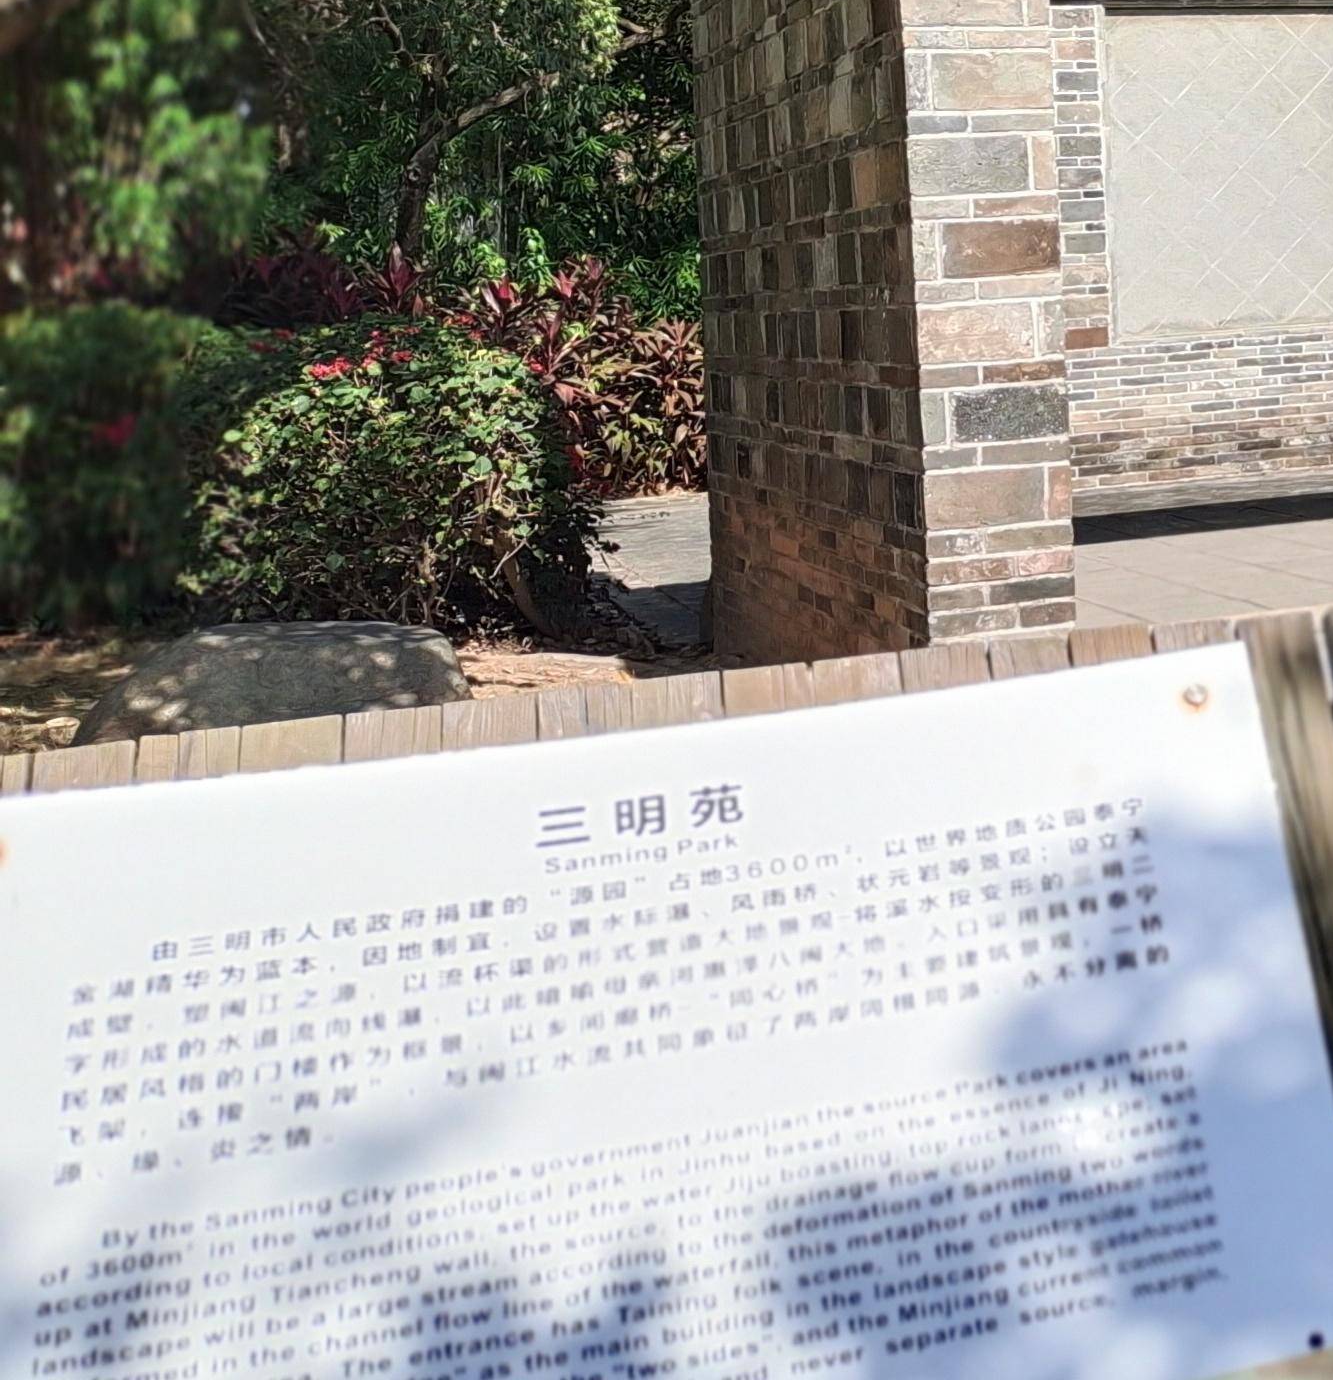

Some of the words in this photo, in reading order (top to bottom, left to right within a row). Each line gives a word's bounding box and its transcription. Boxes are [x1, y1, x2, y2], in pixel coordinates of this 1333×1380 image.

[535, 783, 744, 848] 三明苑
[544, 845, 668, 874] Sanming
[676, 832, 739, 856] Park
[35, 1274, 191, 1321] according
[203, 1270, 230, 1289] to
[243, 1252, 313, 1281] local
[497, 1212, 535, 1235] set
[547, 1207, 579, 1227] up
[590, 1194, 630, 1217] the
[642, 1182, 712, 1208] water
[907, 1136, 948, 1158] top
[957, 1121, 1009, 1146] rock
[38, 1267, 70, 1289] of
[209, 1240, 235, 1258] in
[251, 1227, 295, 1251] the
[312, 1210, 391, 1240] world
[407, 1182, 551, 1227] geological
[567, 1169, 624, 1198] park
[641, 1164, 663, 1181] in
[678, 1146, 750, 1174] Jinhu
[765, 1129, 841, 1158] based
[854, 1124, 885, 1141] on
[897, 1111, 934, 1132] the
[949, 1091, 1050, 1123] essence
[1061, 1081, 1086, 1099] of
[1096, 1074, 1118, 1092] Ji
[101, 1228, 139, 1250] By
[148, 1216, 195, 1240] the
[205, 1194, 332, 1232] Sanming
[341, 1184, 394, 1211] City
[405, 1161, 522, 1202] people's
[531, 1131, 690, 1179] government
[816, 1100, 855, 1122] the
[863, 1086, 945, 1113] source
[954, 1071, 1007, 1095] Park
[1015, 1057, 1096, 1084] covers
[1101, 1050, 1130, 1066] an
[1137, 1039, 1187, 1059] area
[30, 1334, 192, 1380] landscape
[204, 1319, 255, 1345] will
[265, 1314, 299, 1334] be
[311, 1310, 325, 1326] a
[338, 1293, 410, 1323] large
[421, 1273, 517, 1305] stream
[529, 1242, 667, 1286] according
[677, 1238, 701, 1256] to
[713, 1225, 753, 1248] the
[762, 1193, 921, 1239] deformation
[928, 1186, 955, 1206] of
[962, 1162, 1072, 1202] Sanming
[1079, 1153, 1123, 1174] two
[33, 1327, 71, 1350] up
[84, 1316, 113, 1338] at
[124, 1290, 256, 1335] Minjiang
[270, 1260, 421, 1306] Tiancheng
[509, 1236, 551, 1260] the
[678, 1211, 701, 1228] to
[714, 1198, 754, 1221] the
[765, 1178, 878, 1214] drainage
[889, 1165, 939, 1188] flow
[949, 1154, 995, 1177] cup
[1004, 1139, 1062, 1163] form
[212, 1355, 238, 1375] in
[249, 1341, 295, 1367] the
[308, 1317, 423, 1356] channel
[433, 1307, 491, 1332] flow
[502, 1295, 553, 1318] line
[564, 1285, 592, 1306] of
[601, 1275, 642, 1299] the
[788, 1237, 836, 1262] this
[846, 1209, 969, 1252] metaphor
[977, 1202, 1003, 1222] of
[1010, 1192, 1049, 1215] the
[341, 1353, 391, 1380] The
[409, 1327, 534, 1366] entrance
[552, 1314, 599, 1338] has
[618, 1289, 718, 1327] Taining
[733, 1276, 782, 1301] folk
[896, 1249, 921, 1267] in
[934, 1235, 974, 1259] the
[479, 1362, 511, 1380] as
[524, 1346, 568, 1372] the
[580, 1330, 649, 1361] main
[662, 1305, 774, 1346] building
[787, 1300, 810, 1318] in
[820, 1287, 863, 1311] the
[873, 1258, 1007, 1302] landscape
[1017, 1239, 1079, 1270] style
[792, 1319, 840, 1345] and
[847, 1308, 890, 1333] the
[898, 1282, 1010, 1327] Minjiang
[790, 1346, 864, 1374] never
[884, 1313, 999, 1358] separate
